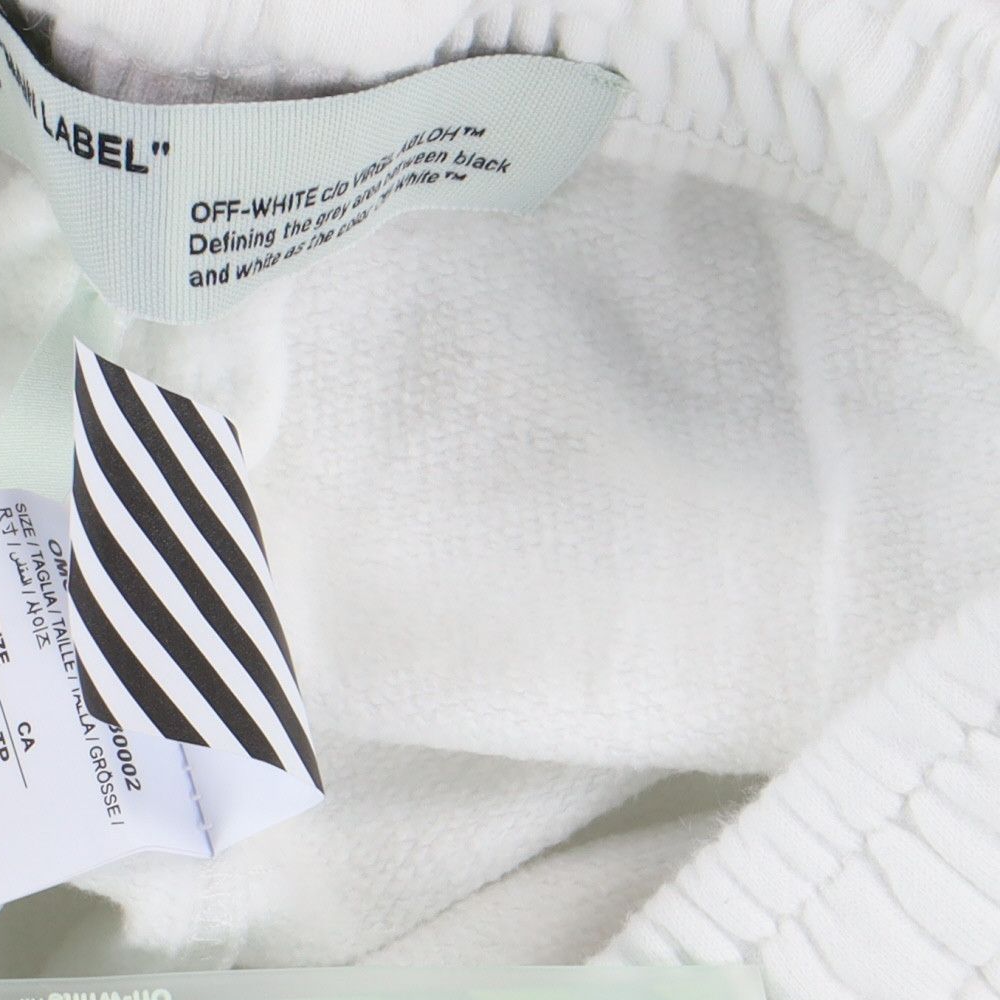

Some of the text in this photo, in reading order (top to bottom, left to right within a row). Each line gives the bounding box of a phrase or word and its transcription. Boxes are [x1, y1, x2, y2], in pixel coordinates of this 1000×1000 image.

[41, 100, 170, 174] LABEL"
[189, 227, 276, 255] Defining
[283, 219, 312, 239] the
[315, 201, 350, 230] grey
[453, 150, 511, 173] black
[191, 186, 319, 223] OFF-WHITE
[321, 180, 349, 203] c/o
[189, 262, 230, 287] and
[236, 251, 281, 280] white
[284, 242, 305, 260] as
[306, 230, 333, 250] the
[26, 600, 51, 650] 사이즈
[15, 503, 36, 538] SIZE
[31, 550, 60, 608] TAGLIA
[52, 617, 77, 672] TAILLE
[89, 745, 121, 818] GRÖSSE
[17, 722, 35, 752] CA
